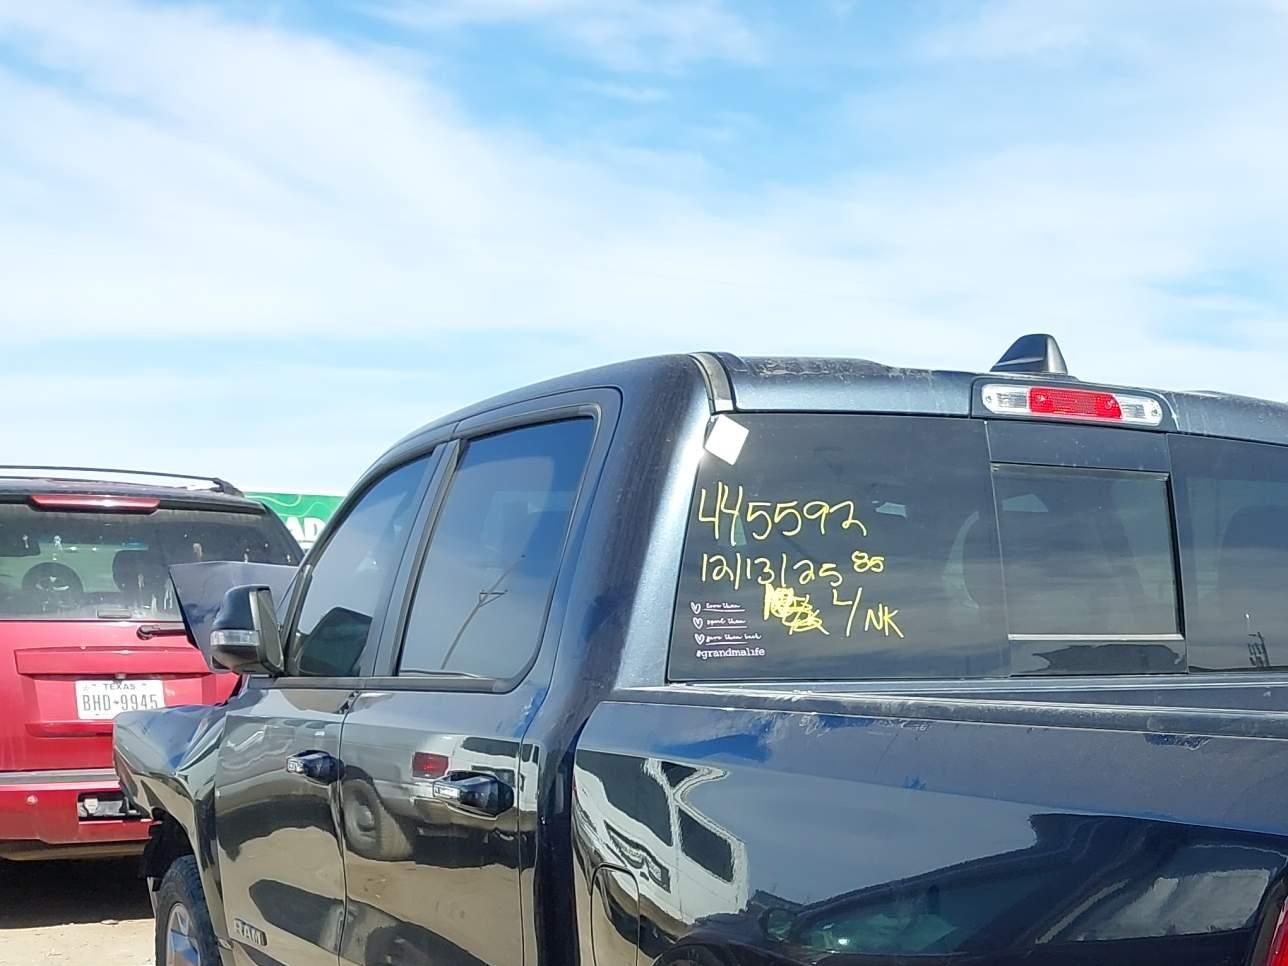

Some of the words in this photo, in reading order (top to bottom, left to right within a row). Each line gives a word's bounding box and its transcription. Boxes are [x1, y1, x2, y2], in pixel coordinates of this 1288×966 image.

[698, 481, 868, 546] 445592
[701, 553, 843, 590] 12/13/25
[851, 550, 884, 573] 85
[103, 683, 137, 691] TEXAS
